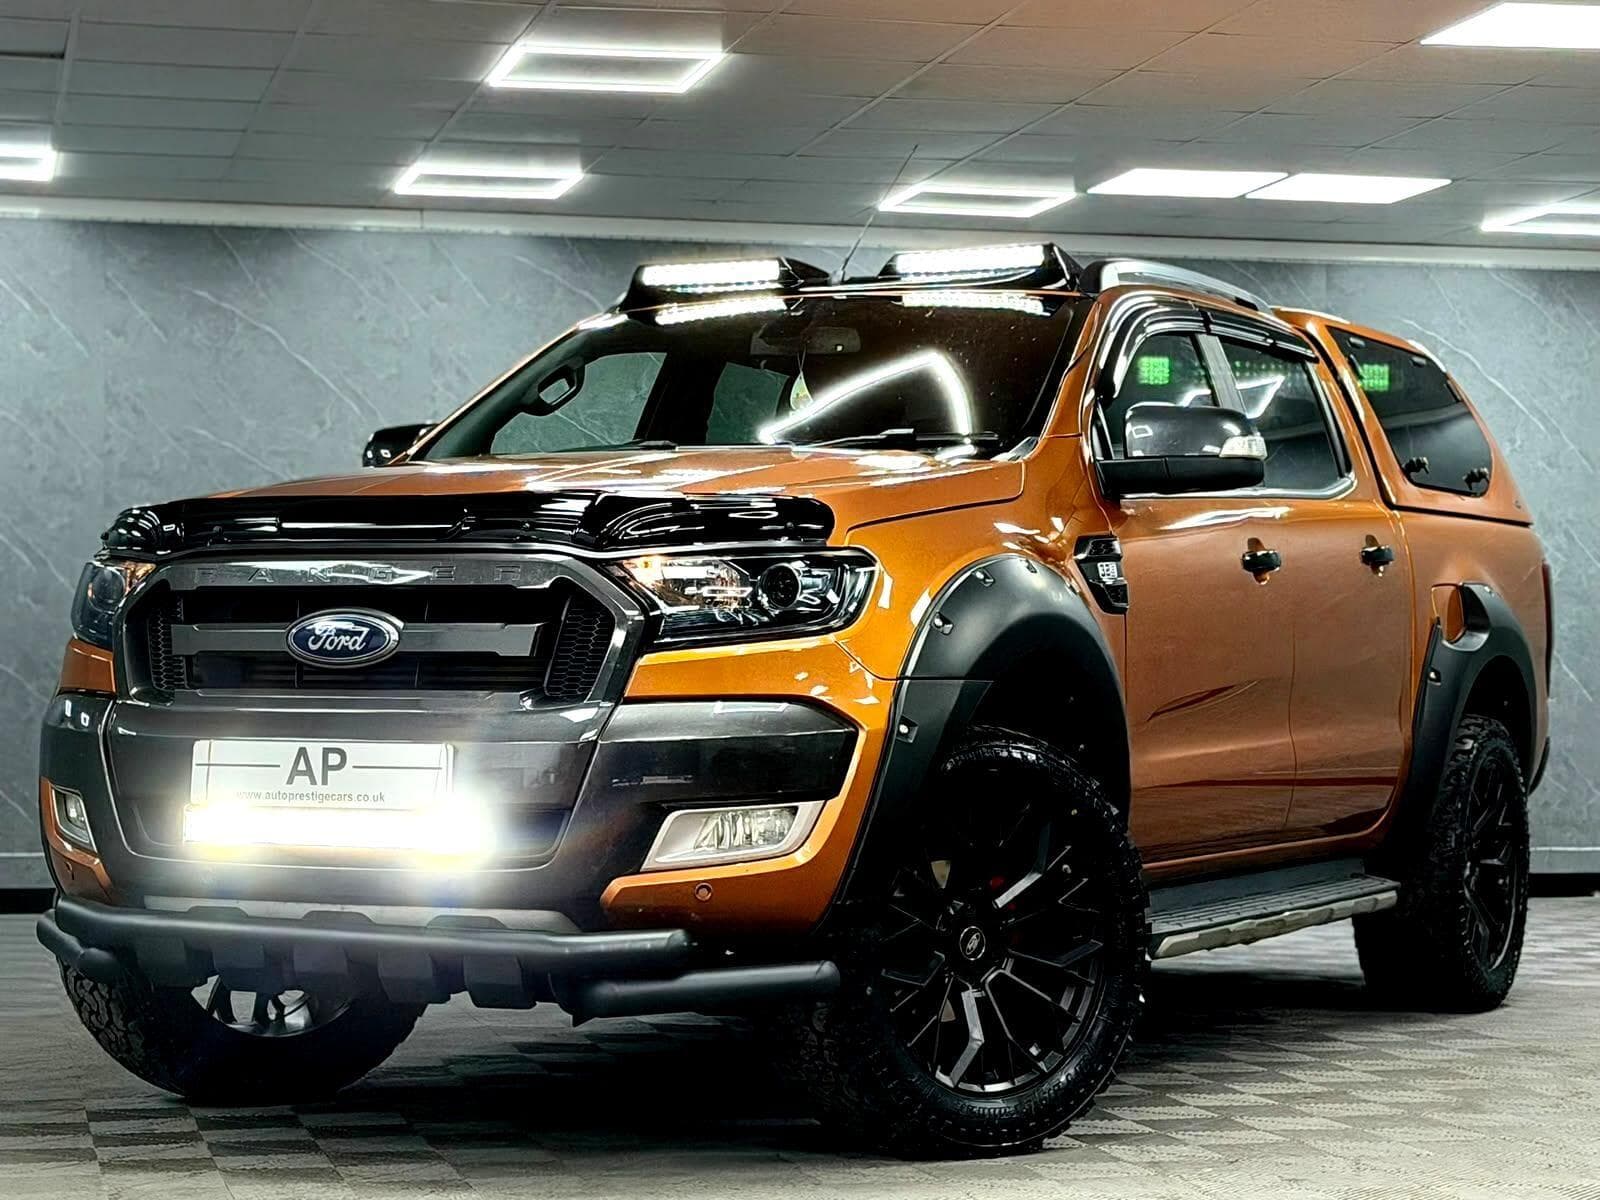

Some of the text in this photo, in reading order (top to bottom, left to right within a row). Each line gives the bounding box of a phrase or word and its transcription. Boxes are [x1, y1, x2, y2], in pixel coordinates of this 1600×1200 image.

[194, 565, 521, 583] RANGER
[306, 620, 370, 650] Ford
[286, 746, 348, 786] AP
[236, 789, 385, 803] www.autoprestigecars.co.uk
